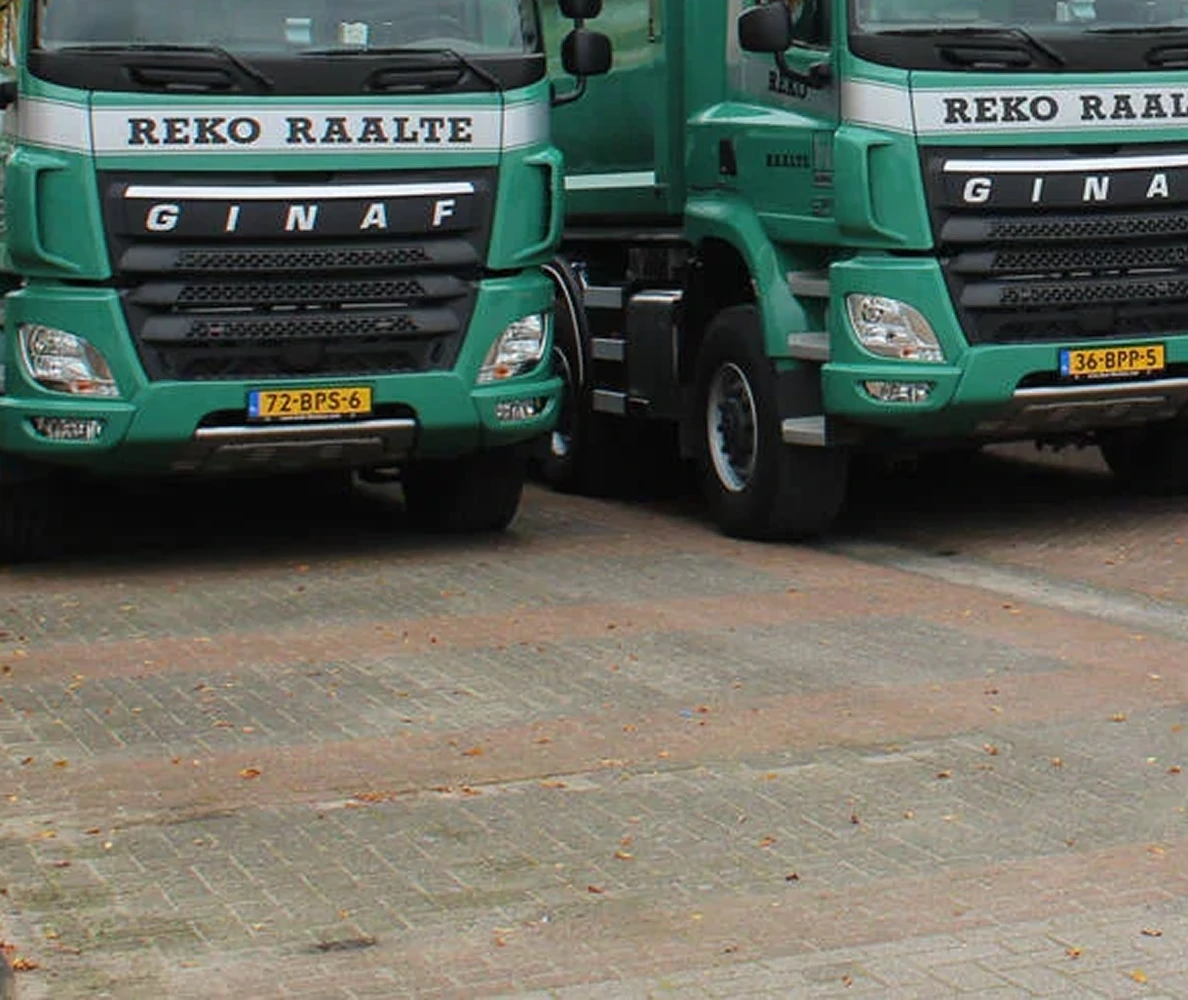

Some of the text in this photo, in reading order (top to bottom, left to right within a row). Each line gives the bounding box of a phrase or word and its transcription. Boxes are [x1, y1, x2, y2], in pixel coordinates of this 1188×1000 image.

[942, 96, 1059, 124] REKO
[127, 116, 473, 145] REKO RAALTE
[145, 199, 456, 232] GINAF
[1075, 348, 1157, 371] 36-BPP-5
[265, 390, 362, 413] 72-BPS-6
